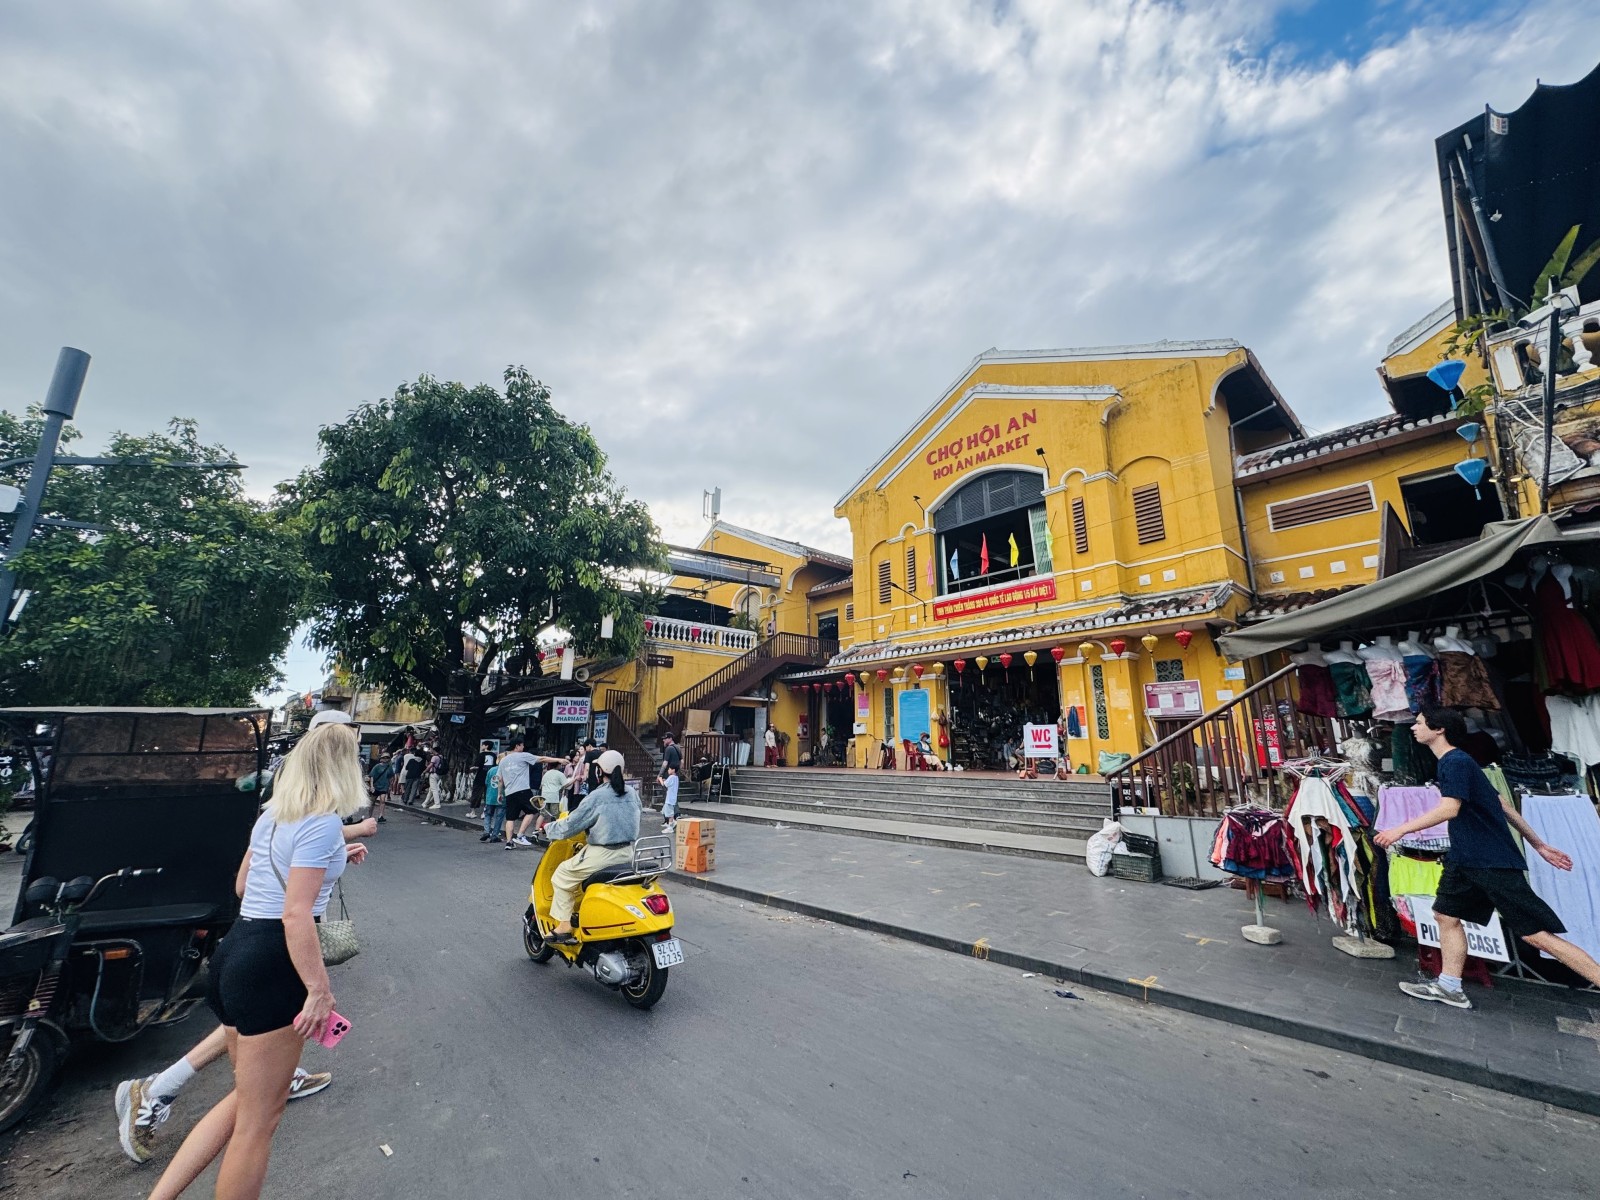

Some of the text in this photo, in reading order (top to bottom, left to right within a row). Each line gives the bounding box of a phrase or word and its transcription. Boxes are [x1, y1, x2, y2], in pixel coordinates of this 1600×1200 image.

[926, 408, 1037, 465] CHỢ HỘI AN
[933, 433, 1029, 480] HOI AN MARKET
[557, 707, 588, 715] 205
[594, 729, 605, 739] 205
[1031, 728, 1051, 742] WC
[1467, 933, 1502, 955] CASE
